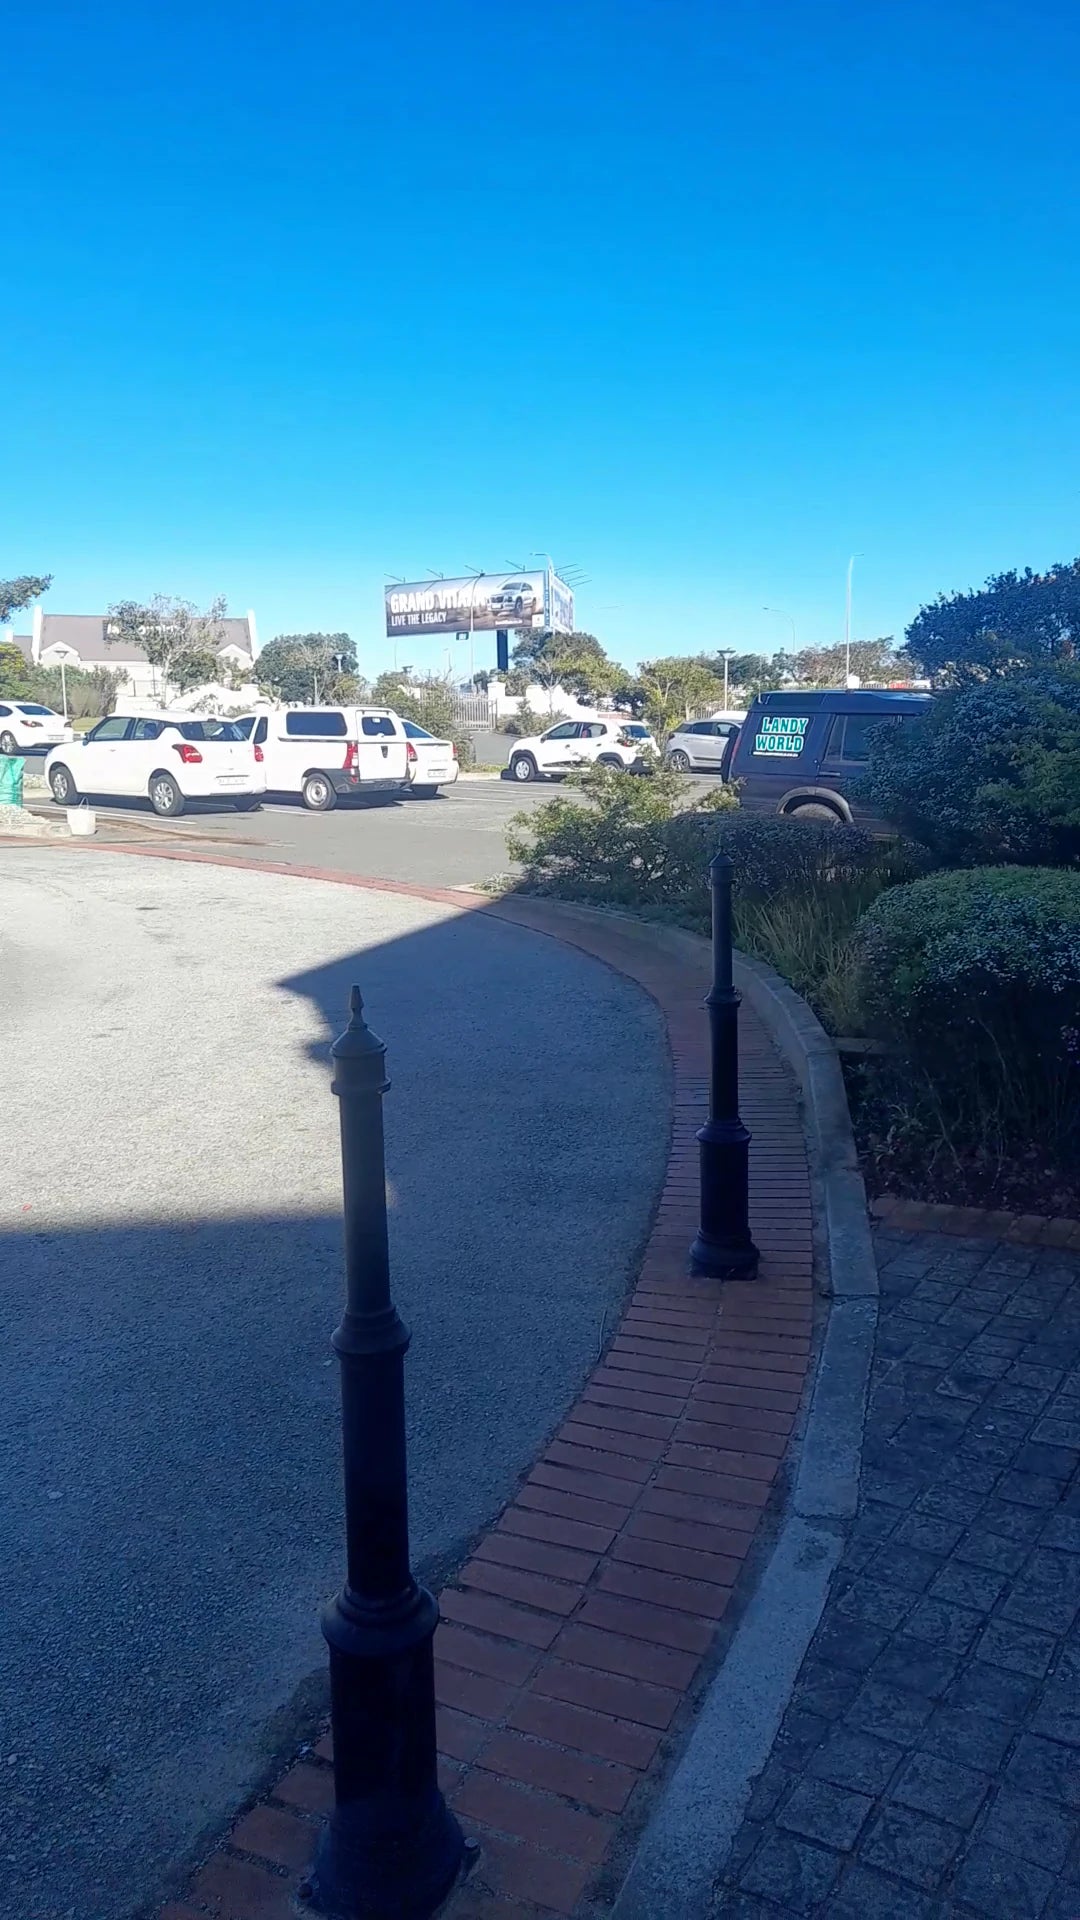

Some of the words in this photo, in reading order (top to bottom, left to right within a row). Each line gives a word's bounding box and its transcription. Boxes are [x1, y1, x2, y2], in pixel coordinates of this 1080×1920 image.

[390, 591, 434, 612] GRAND
[391, 615, 405, 625] LIVE
[407, 614, 419, 625] THE
[421, 612, 446, 624] LEGACY
[762, 717, 808, 734] LANDY
[756, 735, 804, 752] WORLD
